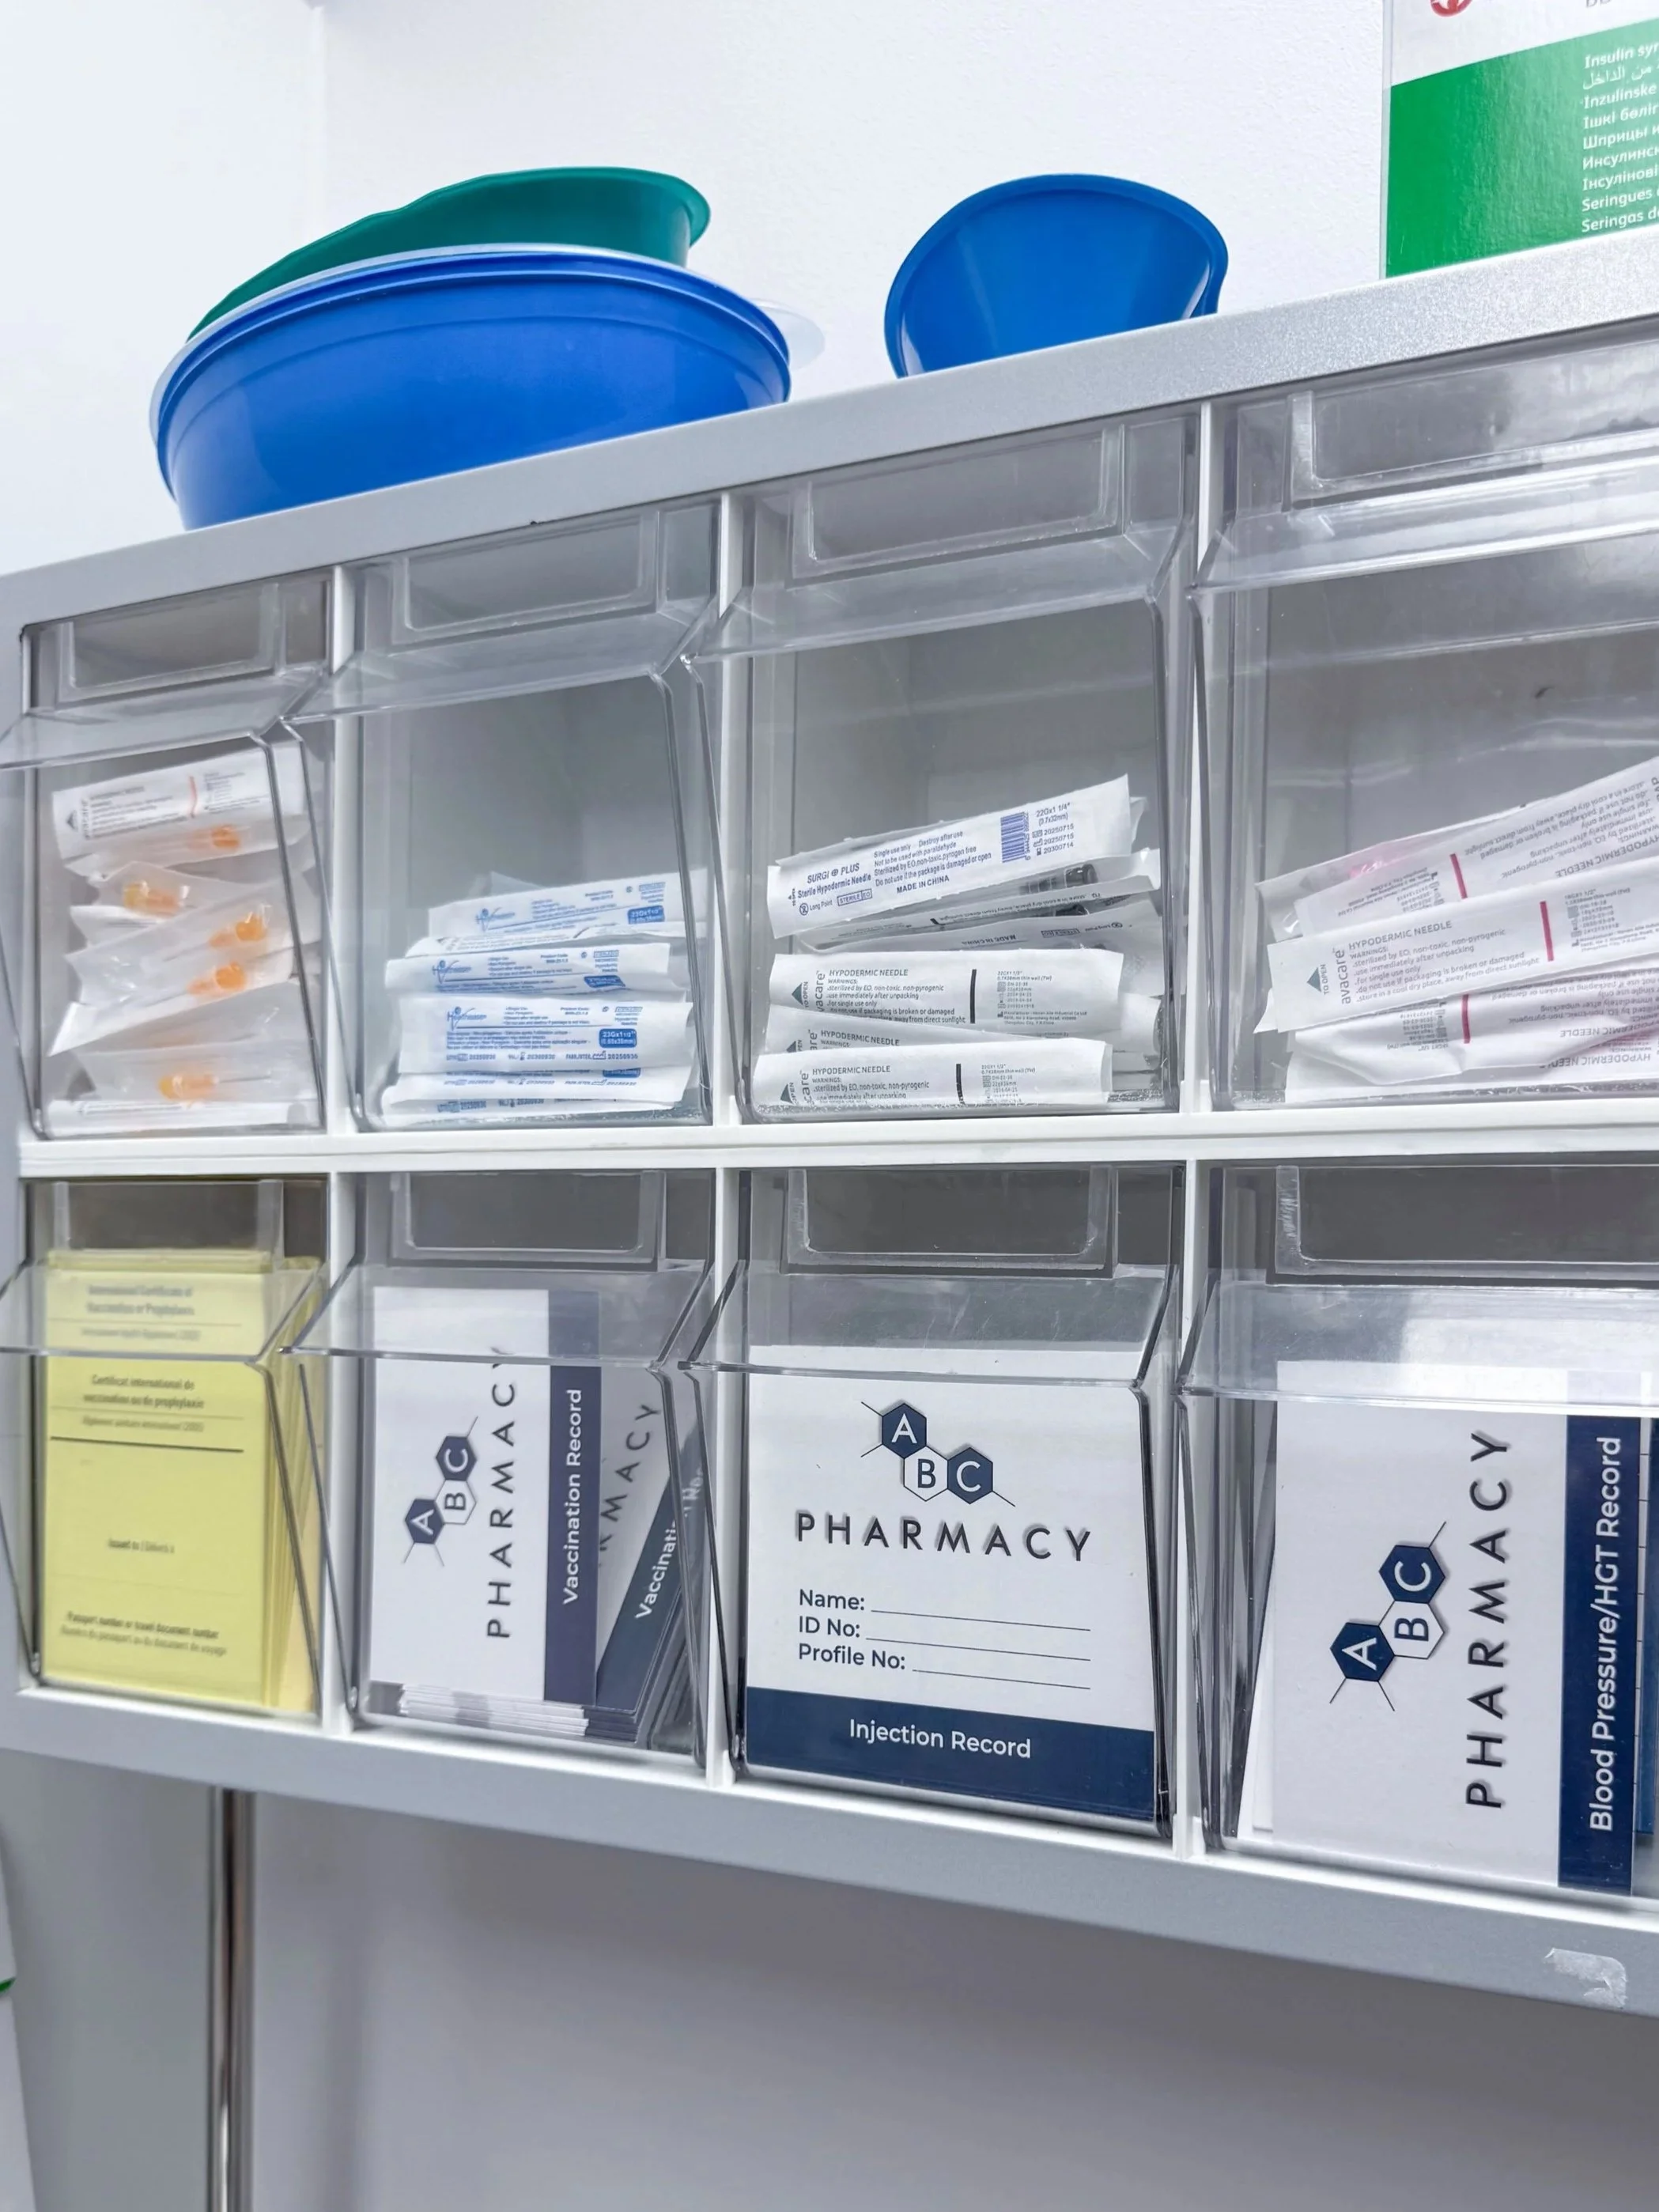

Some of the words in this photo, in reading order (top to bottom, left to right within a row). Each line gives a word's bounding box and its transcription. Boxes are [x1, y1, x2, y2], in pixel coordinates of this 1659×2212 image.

[1584, 47, 1634, 69] Insulin
[1584, 83, 1657, 109] Inzulinske
[1583, 128, 1648, 149] Шприцы
[1582, 188, 1653, 212] Seringues
[1582, 211, 1644, 233] Seringas
[917, 836, 939, 848] Destroy
[806, 870, 830, 883] SURGI
[839, 862, 860, 875] PLUS
[873, 864, 899, 876] Sterilized
[965, 845, 977, 853] free
[916, 864, 940, 877] package
[945, 856, 971, 870] damaged
[977, 852, 992, 862] open
[1554, 857, 1593, 879] NEEDLE
[796, 886, 816, 898] Sterile
[815, 878, 851, 894] Hypodermic
[850, 872, 871, 885] Needle
[896, 882, 917, 894] MADE
[926, 874, 949, 886] CHINA
[809, 902, 822, 911] Long
[822, 898, 833, 907] Point
[1348, 928, 1413, 951] HYPODERMIC
[1413, 920, 1452, 936] NEEDLE
[1450, 928, 1506, 947] non-pyrogenic
[1369, 958, 1406, 974] immediately
[1407, 952, 1434, 964] after
[1434, 943, 1474, 959] unpacking
[1403, 969, 1442, 984] packaging
[1450, 961, 1477, 973] broken
[1488, 951, 1525, 966] damaged
[1320, 964, 1328, 984] OPEN
[1335, 949, 1351, 1004] avacare
[1368, 971, 1389, 984] single
[1404, 964, 1421, 976] only
[1392, 985, 1408, 994] cool
[1408, 982, 1420, 992] dry
[1445, 974, 1464, 984] away
[1464, 969, 1483, 979] from
[1484, 963, 1506, 974] direct
[1508, 956, 1539, 970] sunlight
[820, 1030, 870, 1042] HYPODERMIC
[871, 1036, 900, 1046] NEEDLE
[812, 1067, 861, 1076] HYPODERMIC
[861, 1065, 891, 1074] NEEDLE
[567, 1388, 583, 1465] Record
[1595, 1436, 1621, 1538] Record
[562, 1473, 582, 1605] Vaccination
[795, 1511, 1091, 1562] PHARMACY
[799, 1589, 865, 1611] Name:
[799, 1616, 821, 1635] ID
[826, 1619, 861, 1639] No:
[1465, 1431, 1510, 1809] PHARMACY
[1591, 1545, 1619, 1742] Pressure/HGT
[799, 1643, 865, 1667] Profile
[871, 1649, 906, 1670] No:
[849, 1719, 944, 1749] Injection
[950, 1730, 1032, 1760] Record
[1590, 1749, 1615, 1832] Blood
